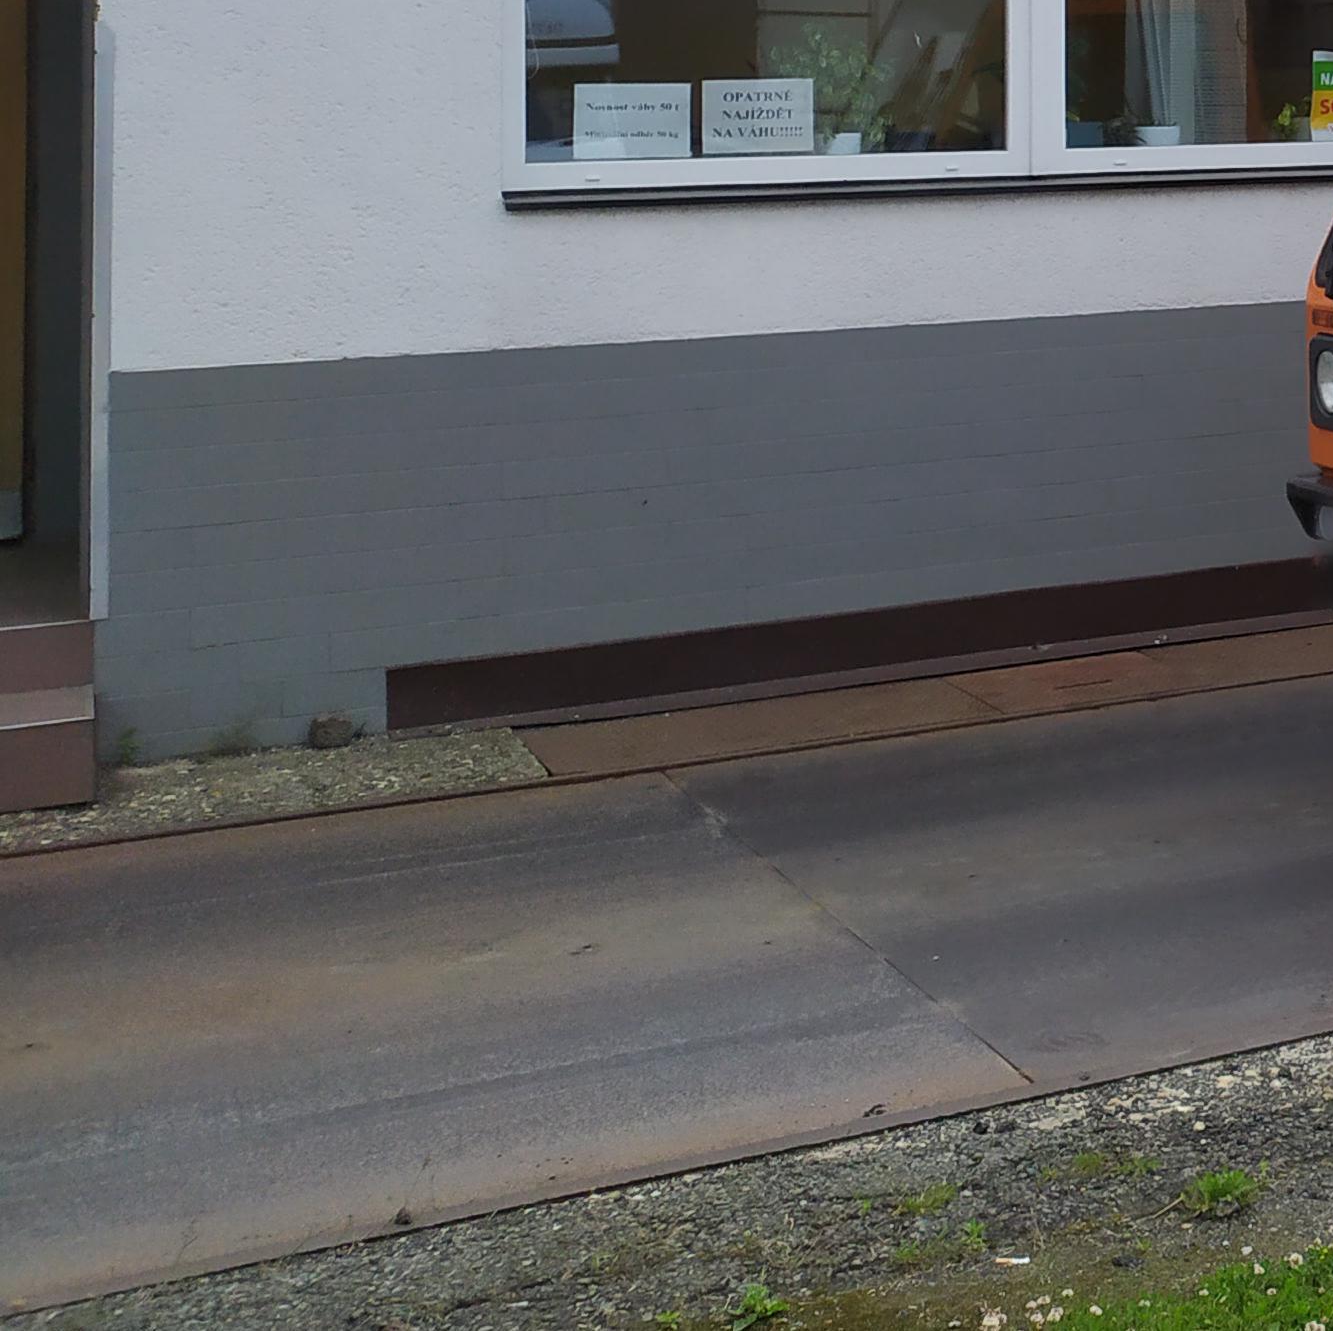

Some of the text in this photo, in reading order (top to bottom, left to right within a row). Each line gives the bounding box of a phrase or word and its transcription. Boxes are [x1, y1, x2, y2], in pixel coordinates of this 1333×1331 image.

[723, 90, 793, 103] OPATRNÉ
[722, 106, 794, 120] NAJÍŽDĚT
[712, 127, 733, 138] NA
